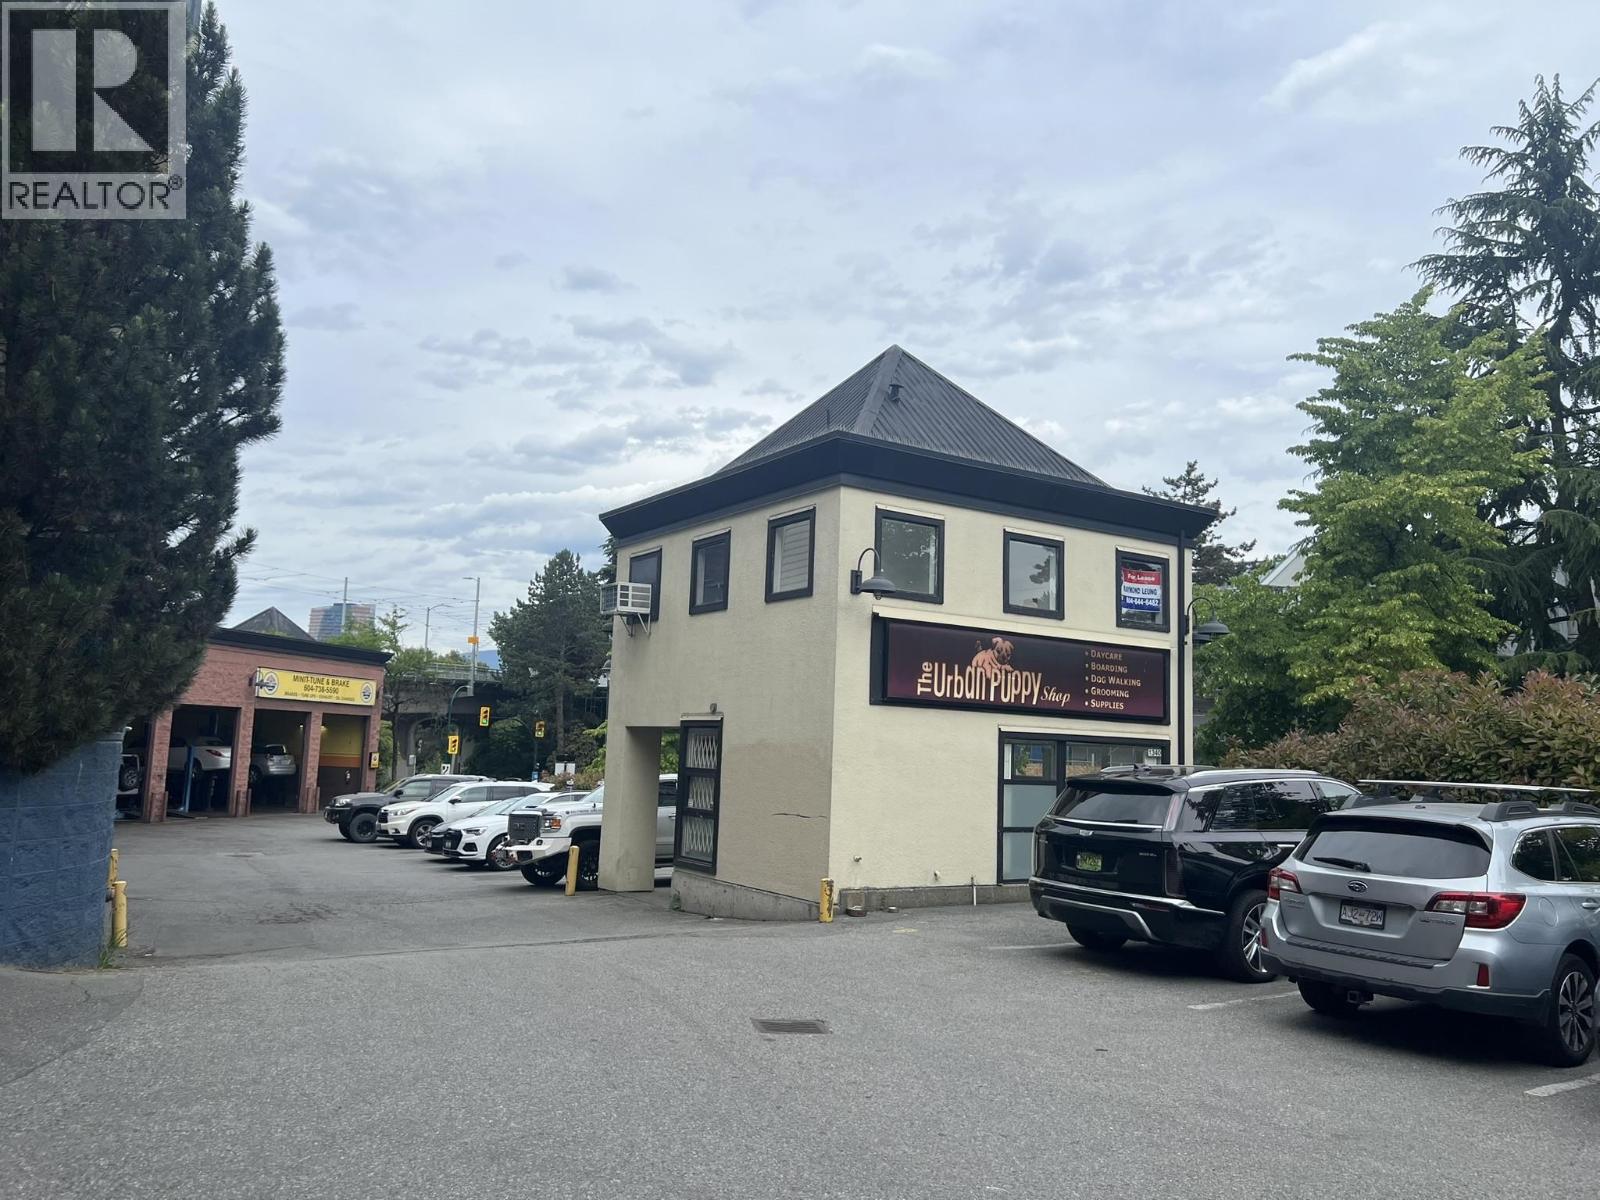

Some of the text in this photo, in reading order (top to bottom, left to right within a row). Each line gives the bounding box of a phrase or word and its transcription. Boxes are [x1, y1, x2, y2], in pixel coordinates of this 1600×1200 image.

[1090, 649, 1123, 661] DAYCARE
[1090, 661, 1128, 674] BOARDING
[331, 678, 350, 688] BRAKE
[916, 661, 1072, 708] The Urban Puppy Shop
[1090, 674, 1142, 687] DOG WALKING
[1090, 686, 1130, 698] GROOMING
[1090, 699, 1125, 710] SUPPLIES
